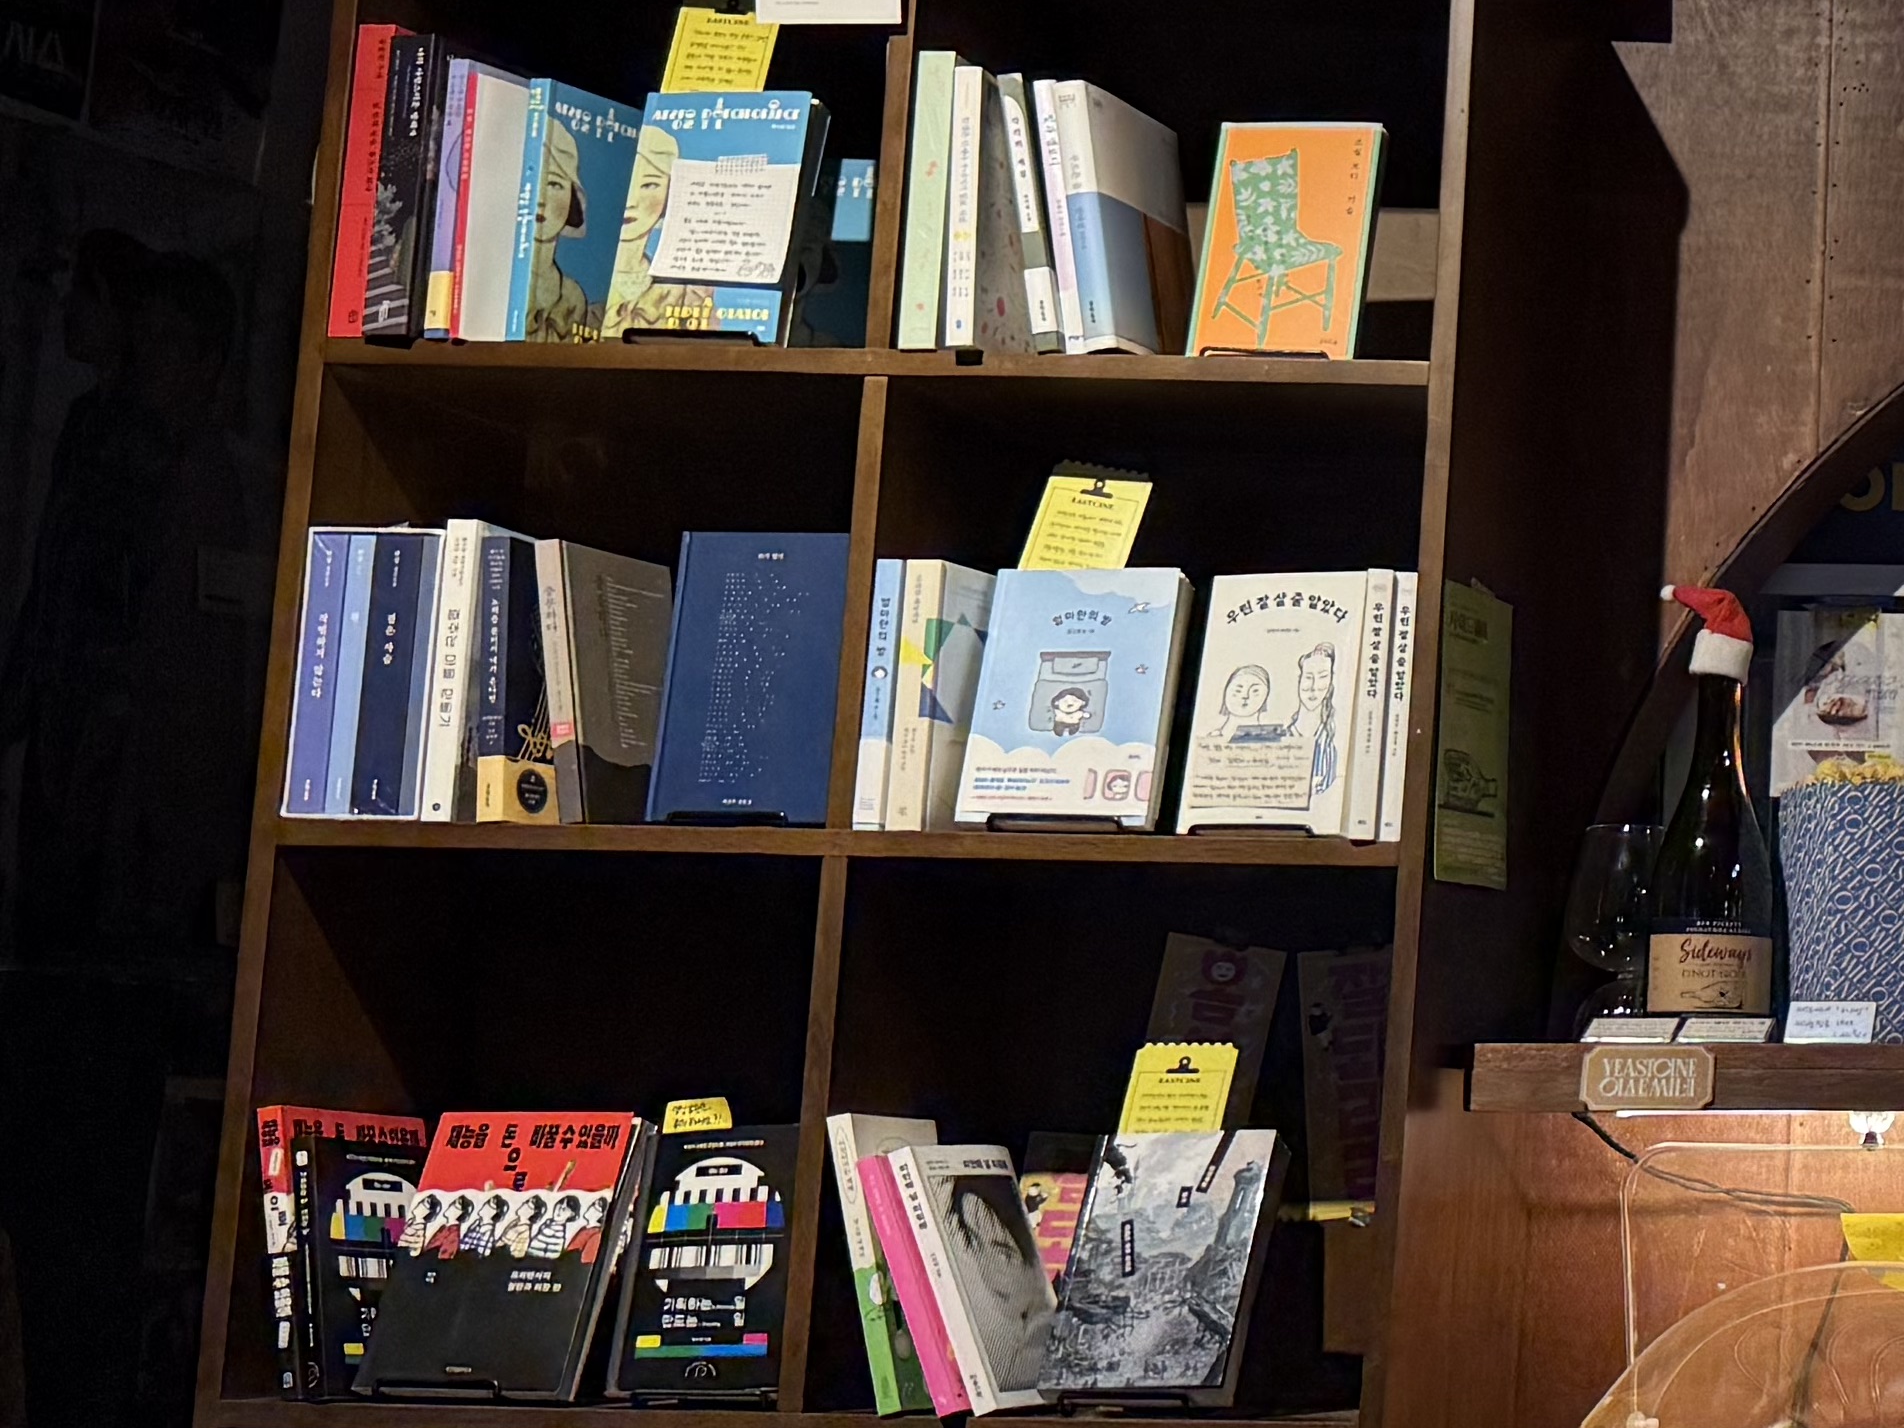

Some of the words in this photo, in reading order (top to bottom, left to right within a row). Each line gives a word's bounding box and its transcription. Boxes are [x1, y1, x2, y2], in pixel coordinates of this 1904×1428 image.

[1225, 600, 1255, 625] 우린
[1255, 595, 1269, 610] 잘
[1272, 592, 1287, 607] 살
[1307, 594, 1349, 623] 알았다
[1679, 938, 1752, 969] Sideways
[446, 1123, 490, 1149] 재능을
[559, 1124, 576, 1149] 수
